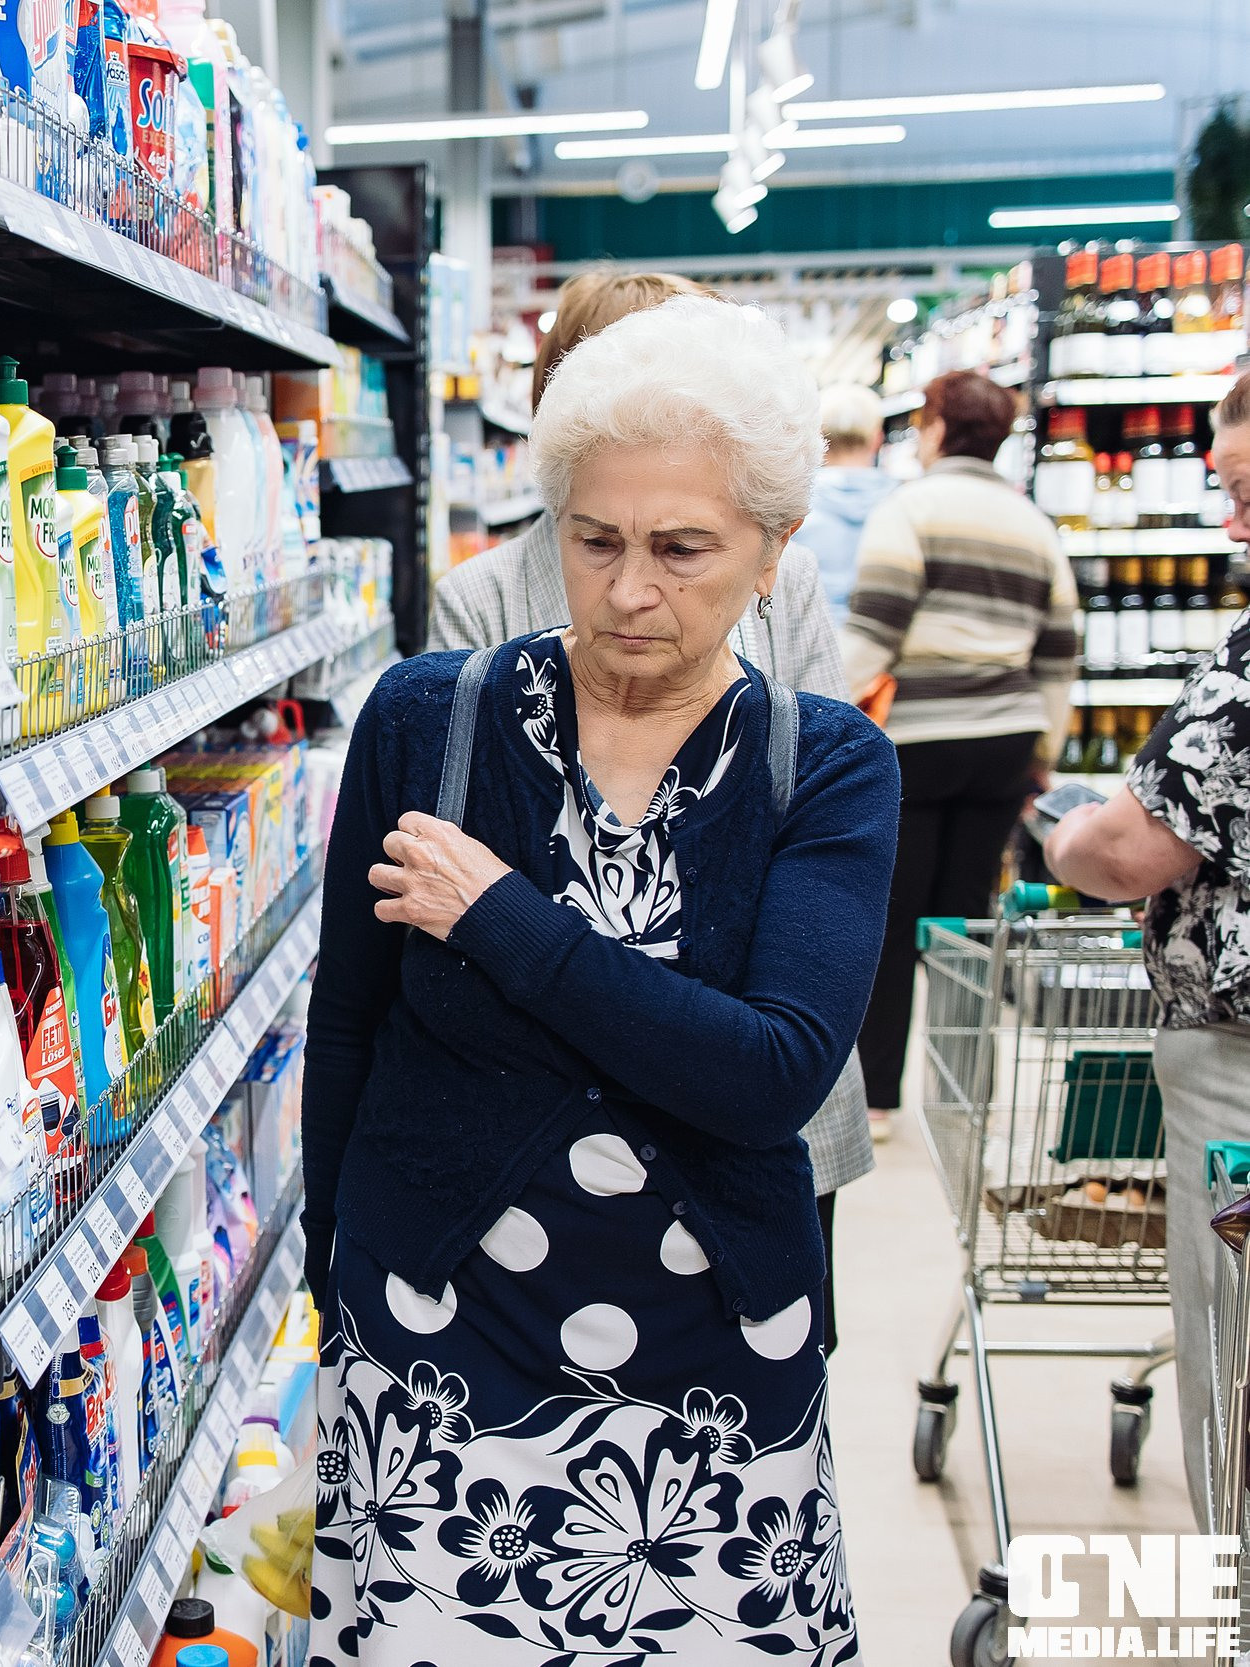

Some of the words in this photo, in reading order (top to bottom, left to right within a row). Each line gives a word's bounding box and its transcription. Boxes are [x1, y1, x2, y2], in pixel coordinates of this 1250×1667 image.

[41, 1020, 65, 1051] FETT
[41, 1045, 67, 1066] Löser
[87, 1262, 101, 1284] 225
[62, 1298, 77, 1322] 255
[30, 1344, 48, 1367] 324
